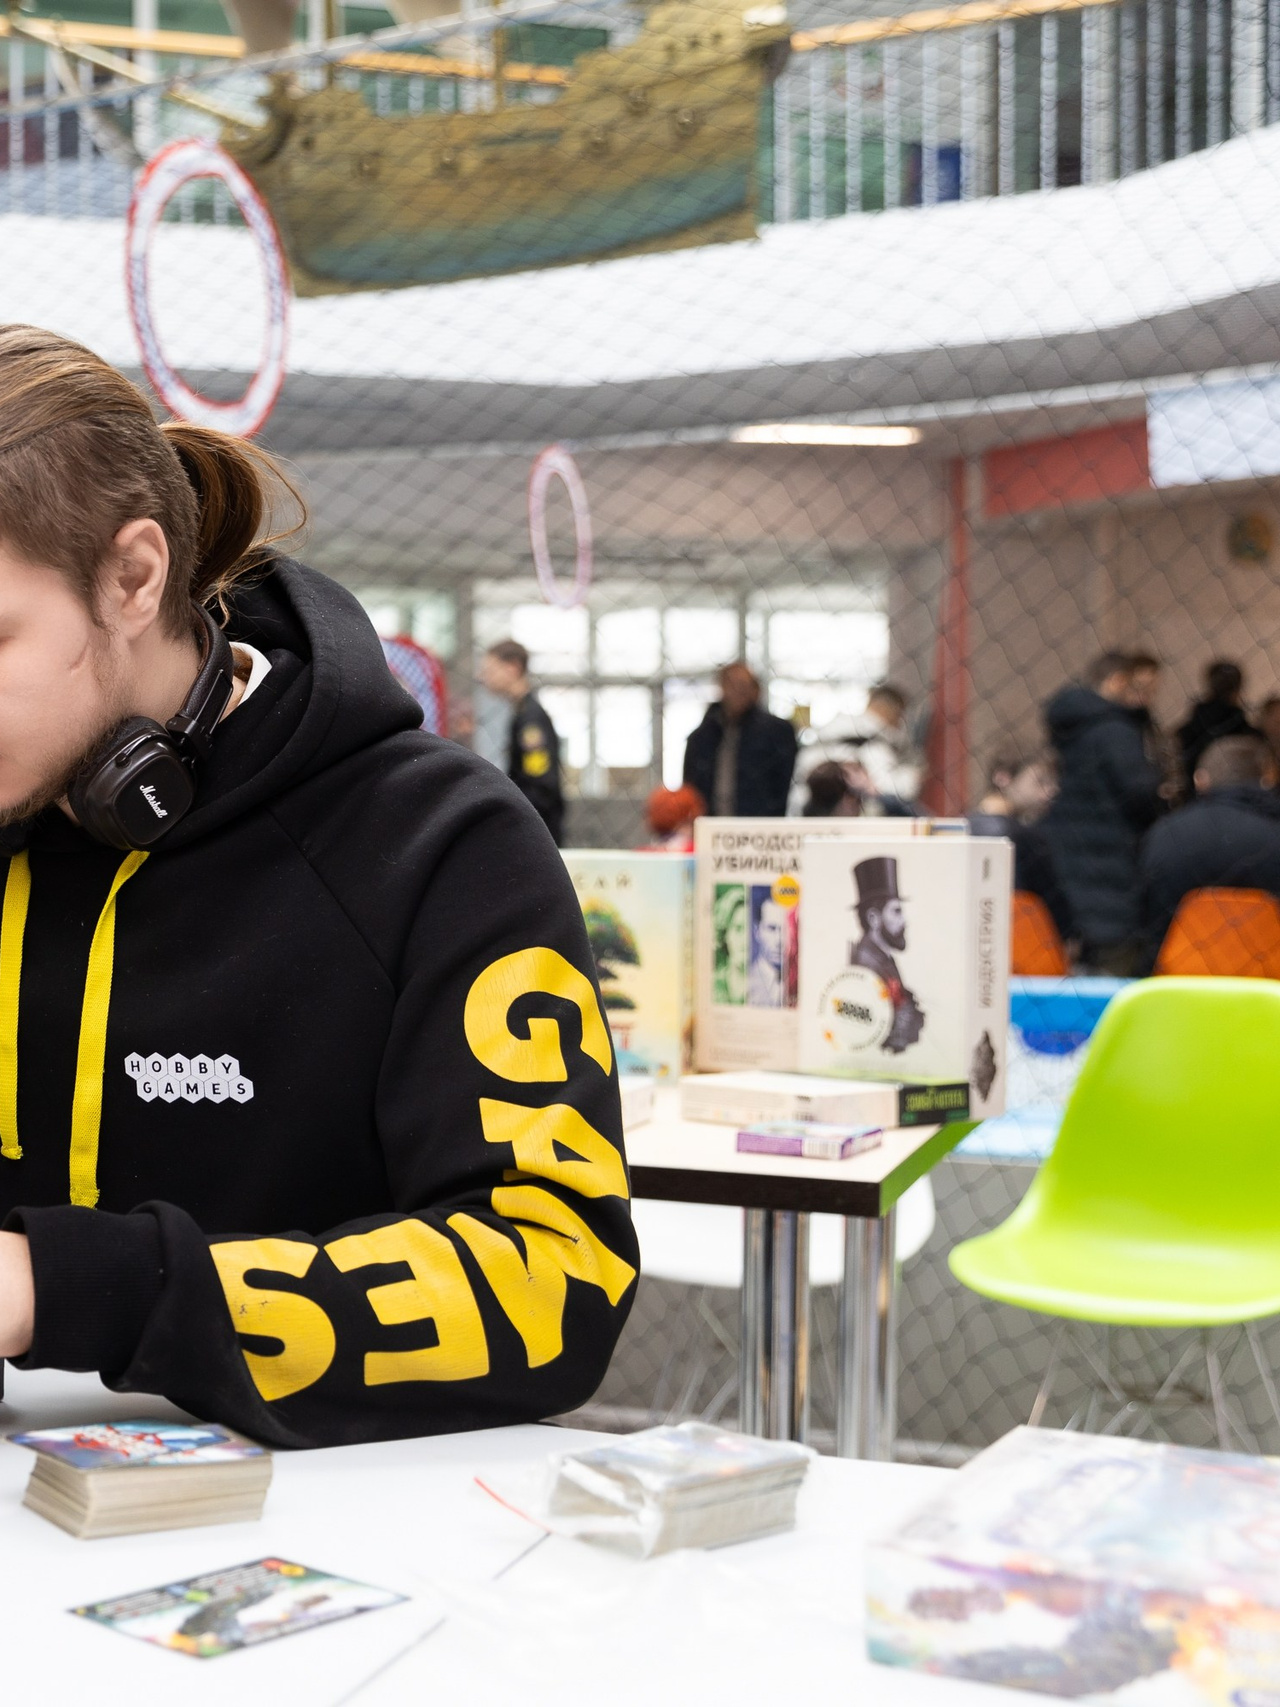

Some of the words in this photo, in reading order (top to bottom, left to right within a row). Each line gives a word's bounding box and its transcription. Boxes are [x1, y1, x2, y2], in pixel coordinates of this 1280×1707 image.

[139, 784, 168, 819] Marshall
[711, 831, 805, 850] ГОРОДС
[127, 1057, 235, 1077] HOBBY
[140, 1079, 249, 1099] GAMES
